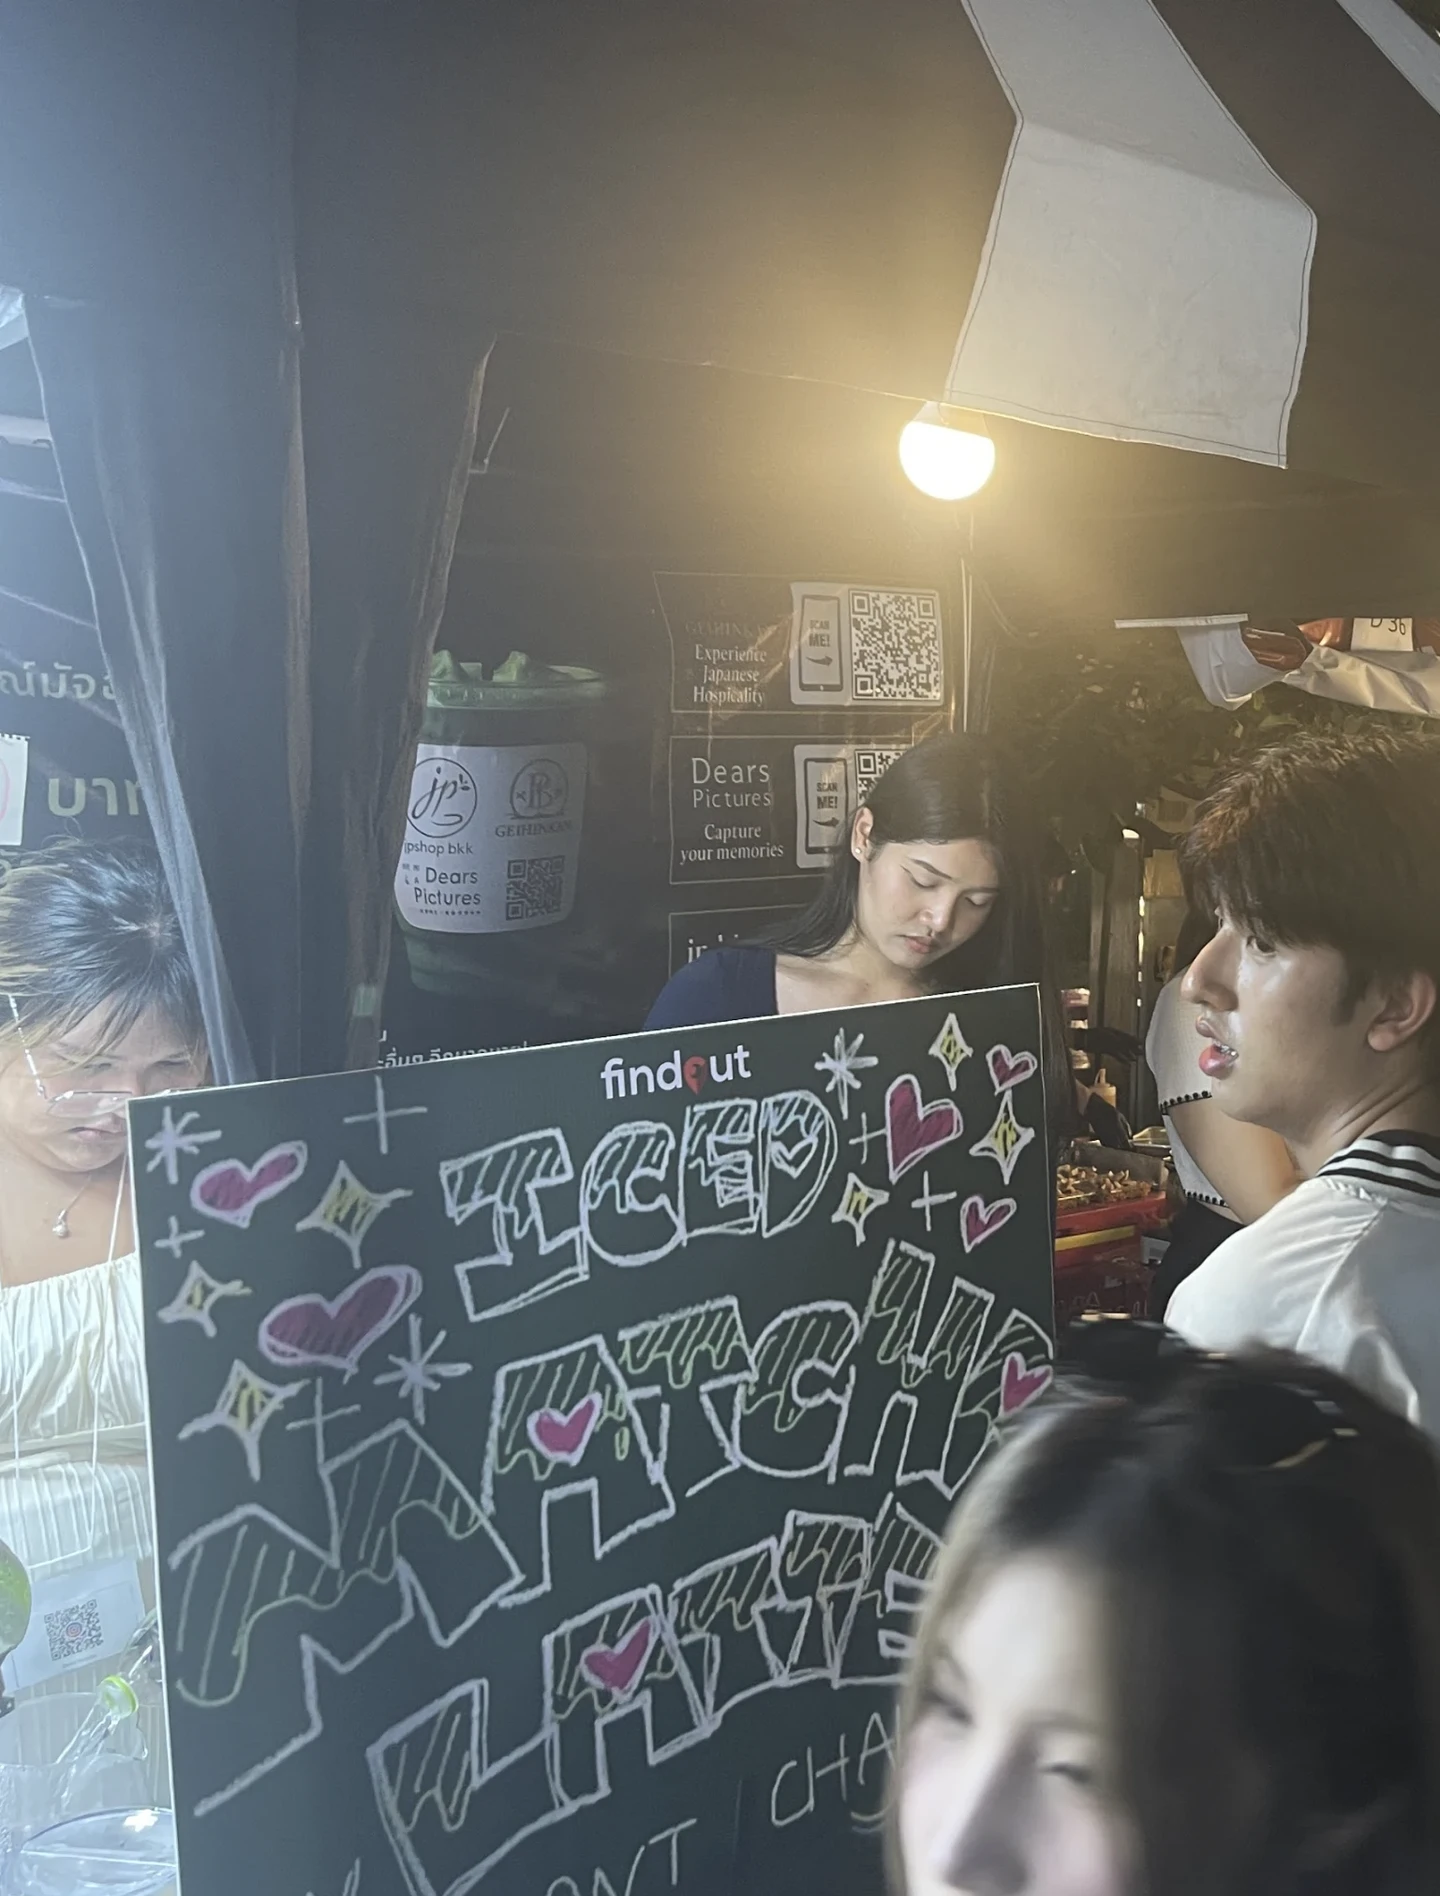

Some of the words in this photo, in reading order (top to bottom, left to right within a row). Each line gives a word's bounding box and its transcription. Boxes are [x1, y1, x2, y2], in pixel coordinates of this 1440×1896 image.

[809, 619, 830, 631] SCAN
[808, 633, 830, 647] ME!
[695, 643, 767, 664] Experience
[703, 665, 760, 685] Japanese
[691, 757, 771, 784] Dears
[816, 782, 839, 794] SCAN
[692, 788, 772, 808] Pictures
[816, 795, 839, 810] ME!
[704, 823, 762, 843] Capture
[448, 841, 474, 855] bkk
[680, 848, 714, 866] your
[716, 843, 784, 861] memories
[425, 867, 479, 885] Dears
[413, 887, 481, 906] Pictures
[440, 1089, 838, 1322] ICED
